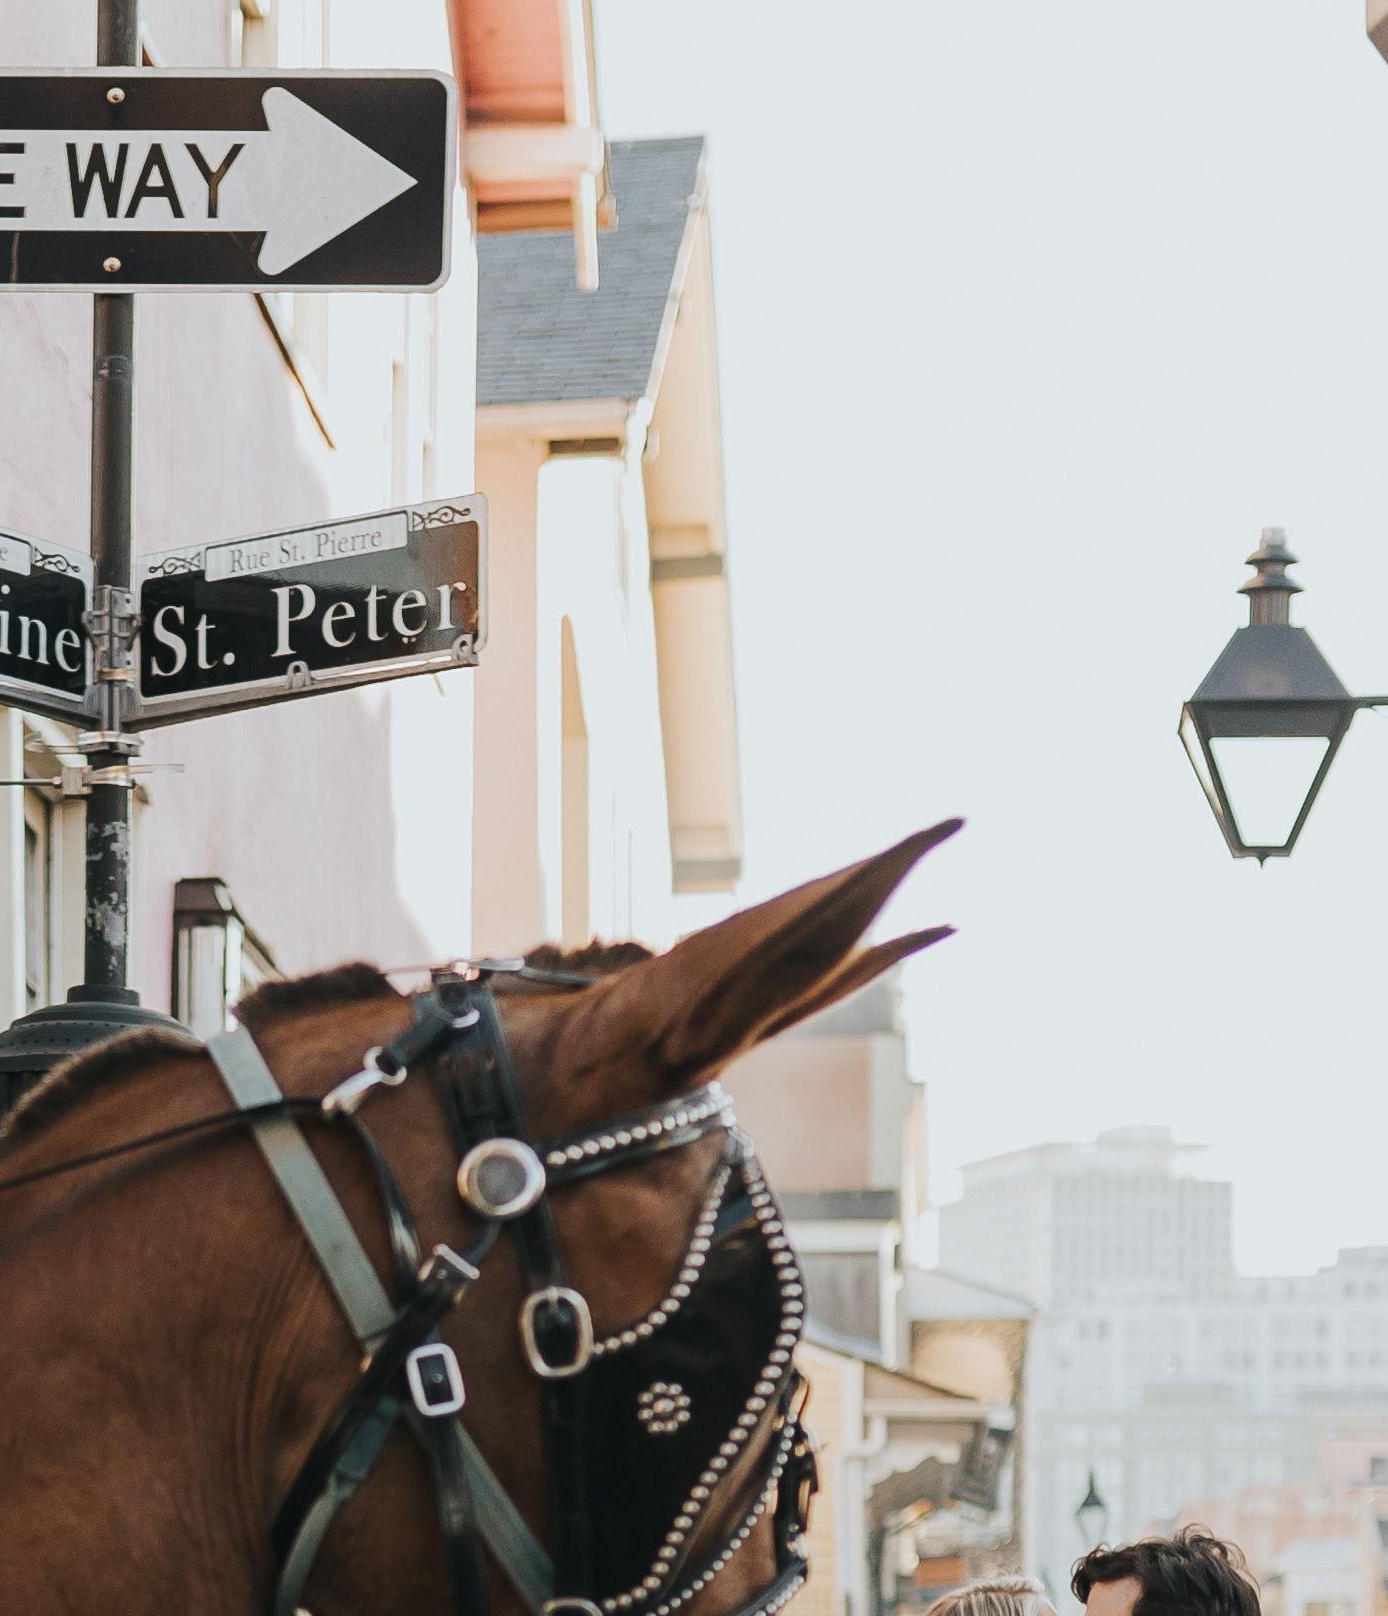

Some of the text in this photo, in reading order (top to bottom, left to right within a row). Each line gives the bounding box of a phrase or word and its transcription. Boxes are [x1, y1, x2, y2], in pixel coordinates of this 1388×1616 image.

[65, 141, 246, 220] WAY
[229, 528, 382, 574] Rue St. Pierre
[150, 580, 468, 677] St. Peter
